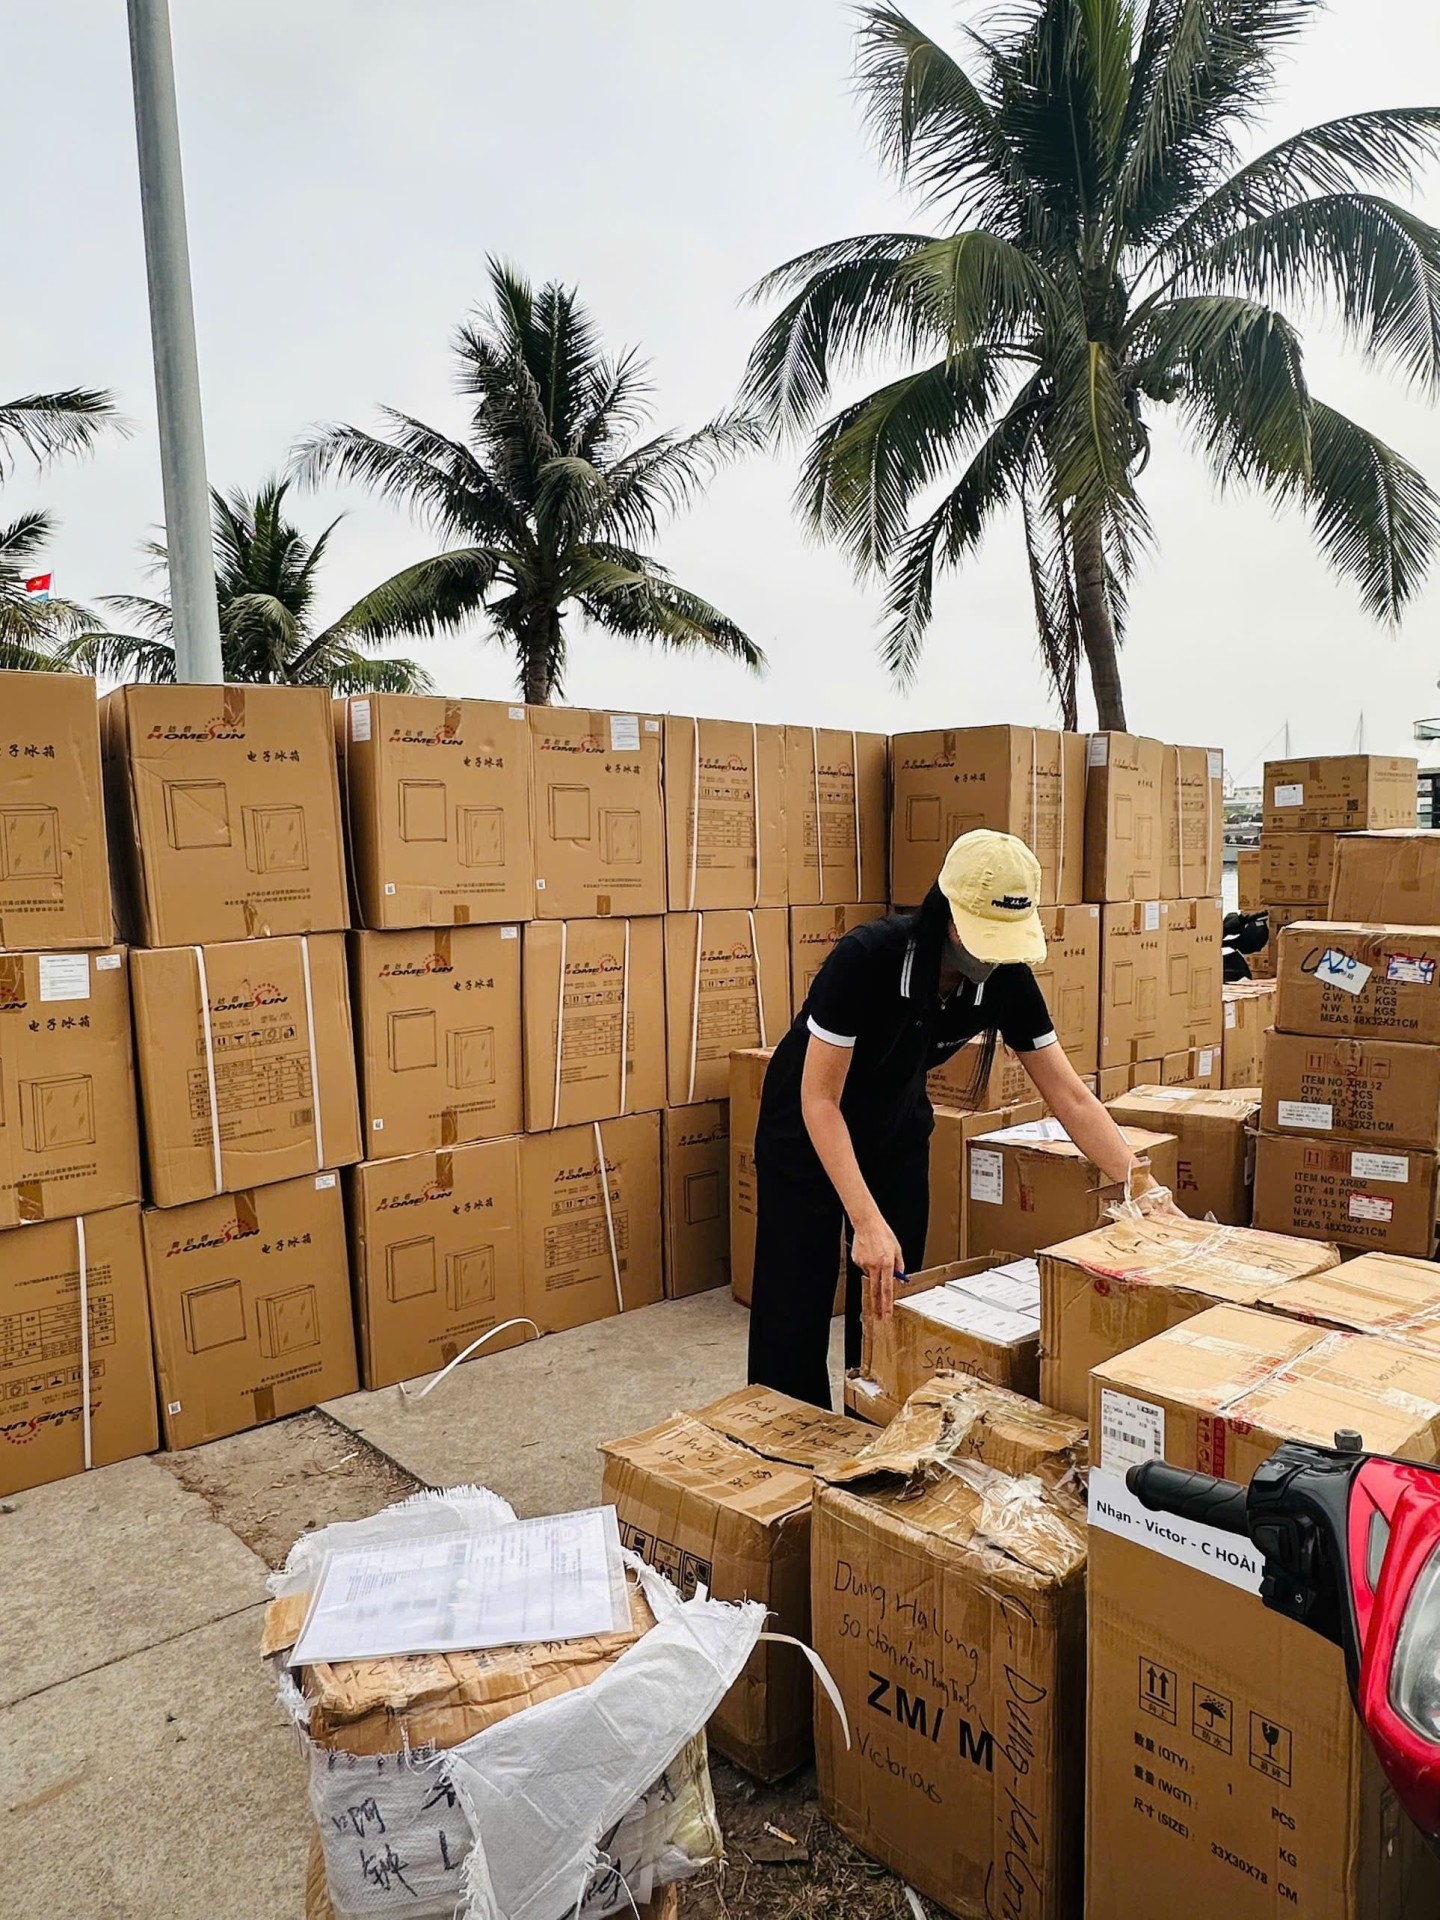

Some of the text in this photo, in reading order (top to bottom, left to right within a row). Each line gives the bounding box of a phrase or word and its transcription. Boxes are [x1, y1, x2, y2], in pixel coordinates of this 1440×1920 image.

[0, 744, 55, 759] 子冰箱
[1376, 986, 1397, 996] PCS
[1375, 997, 1397, 1007] KGS
[1352, 1005, 1363, 1014] 12
[1374, 1007, 1396, 1017] KGS
[29, 1015, 90, 1032] 电子冰箱
[1301, 1075, 1325, 1085] ITEM
[1295, 1172, 1318, 1181] ITEM
[1322, 1211, 1332, 1220] 12
[1097, 1500, 1131, 1524] Nhạn
[1145, 1518, 1187, 1546] Victor
[1201, 1542, 1211, 1556] C
[1216, 1547, 1256, 1574] HOÀI
[839, 1613, 861, 1638] 50
[1227, 1783, 1233, 1795] 1
[1271, 1807, 1296, 1830] PCS
[1134, 1797, 1155, 1818] 尺寸
[1211, 1842, 1268, 1884] 33X30X78
[1277, 1882, 1298, 1904] CM
[1279, 1847, 1297, 1868] KG
